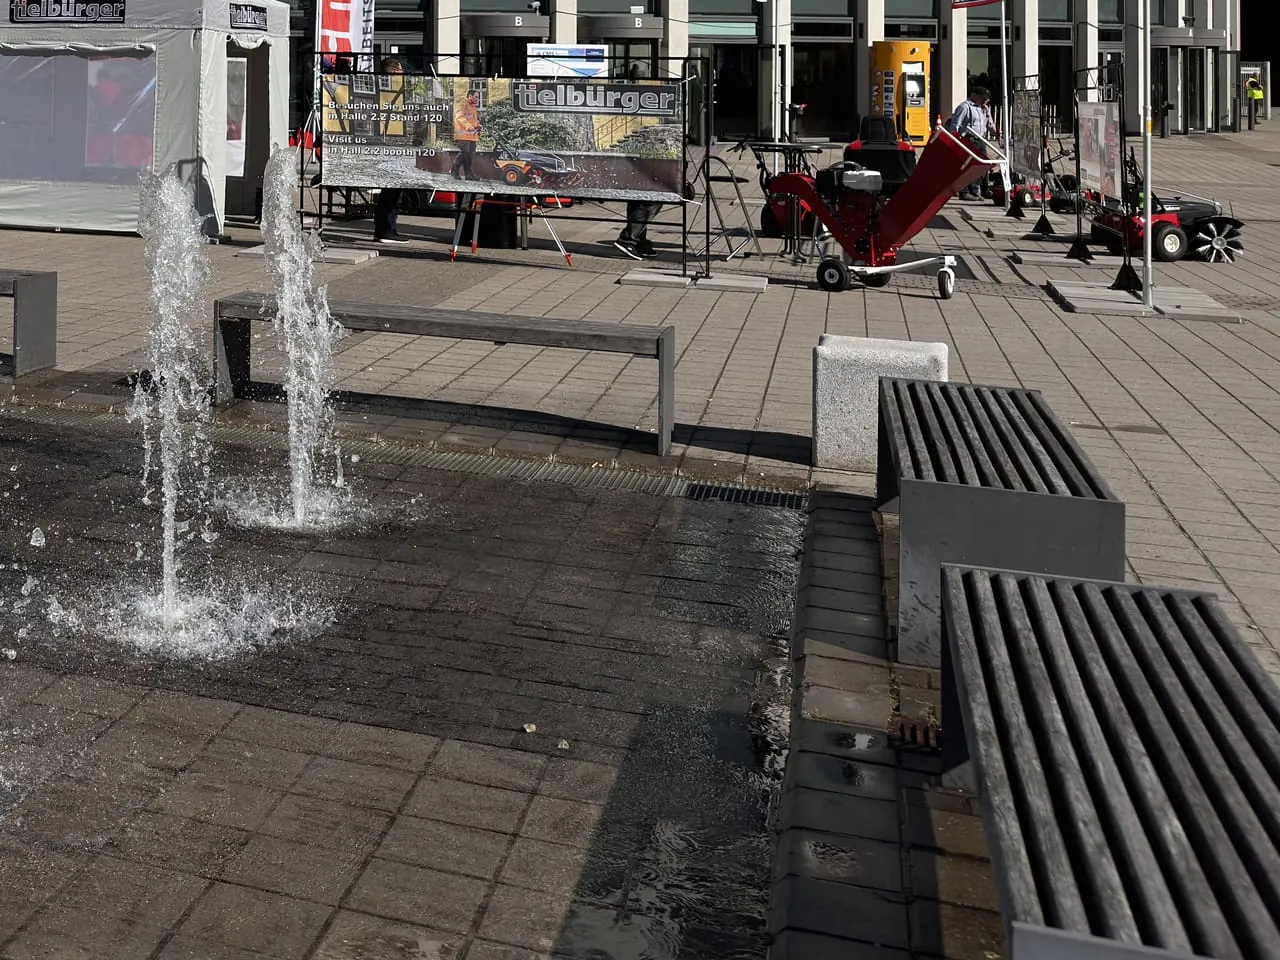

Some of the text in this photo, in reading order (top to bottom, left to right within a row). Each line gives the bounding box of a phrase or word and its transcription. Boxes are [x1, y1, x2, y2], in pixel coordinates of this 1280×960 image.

[11, 0, 124, 21] tielbürger
[515, 16, 523, 26] B
[635, 17, 643, 28] B
[515, 84, 675, 113] tielbürger
[328, 102, 381, 111] Besuchen
[383, 103, 398, 111] Sie
[423, 103, 449, 112] auch
[341, 112, 368, 121] Halle
[370, 113, 387, 121] 2.2
[390, 113, 420, 122] Stand
[424, 114, 443, 122] 120
[328, 135, 352, 143] Visit
[341, 147, 361, 155] Hall
[364, 147, 380, 155] 2.2
[383, 148, 413, 157] booth
[418, 149, 435, 157] 120
